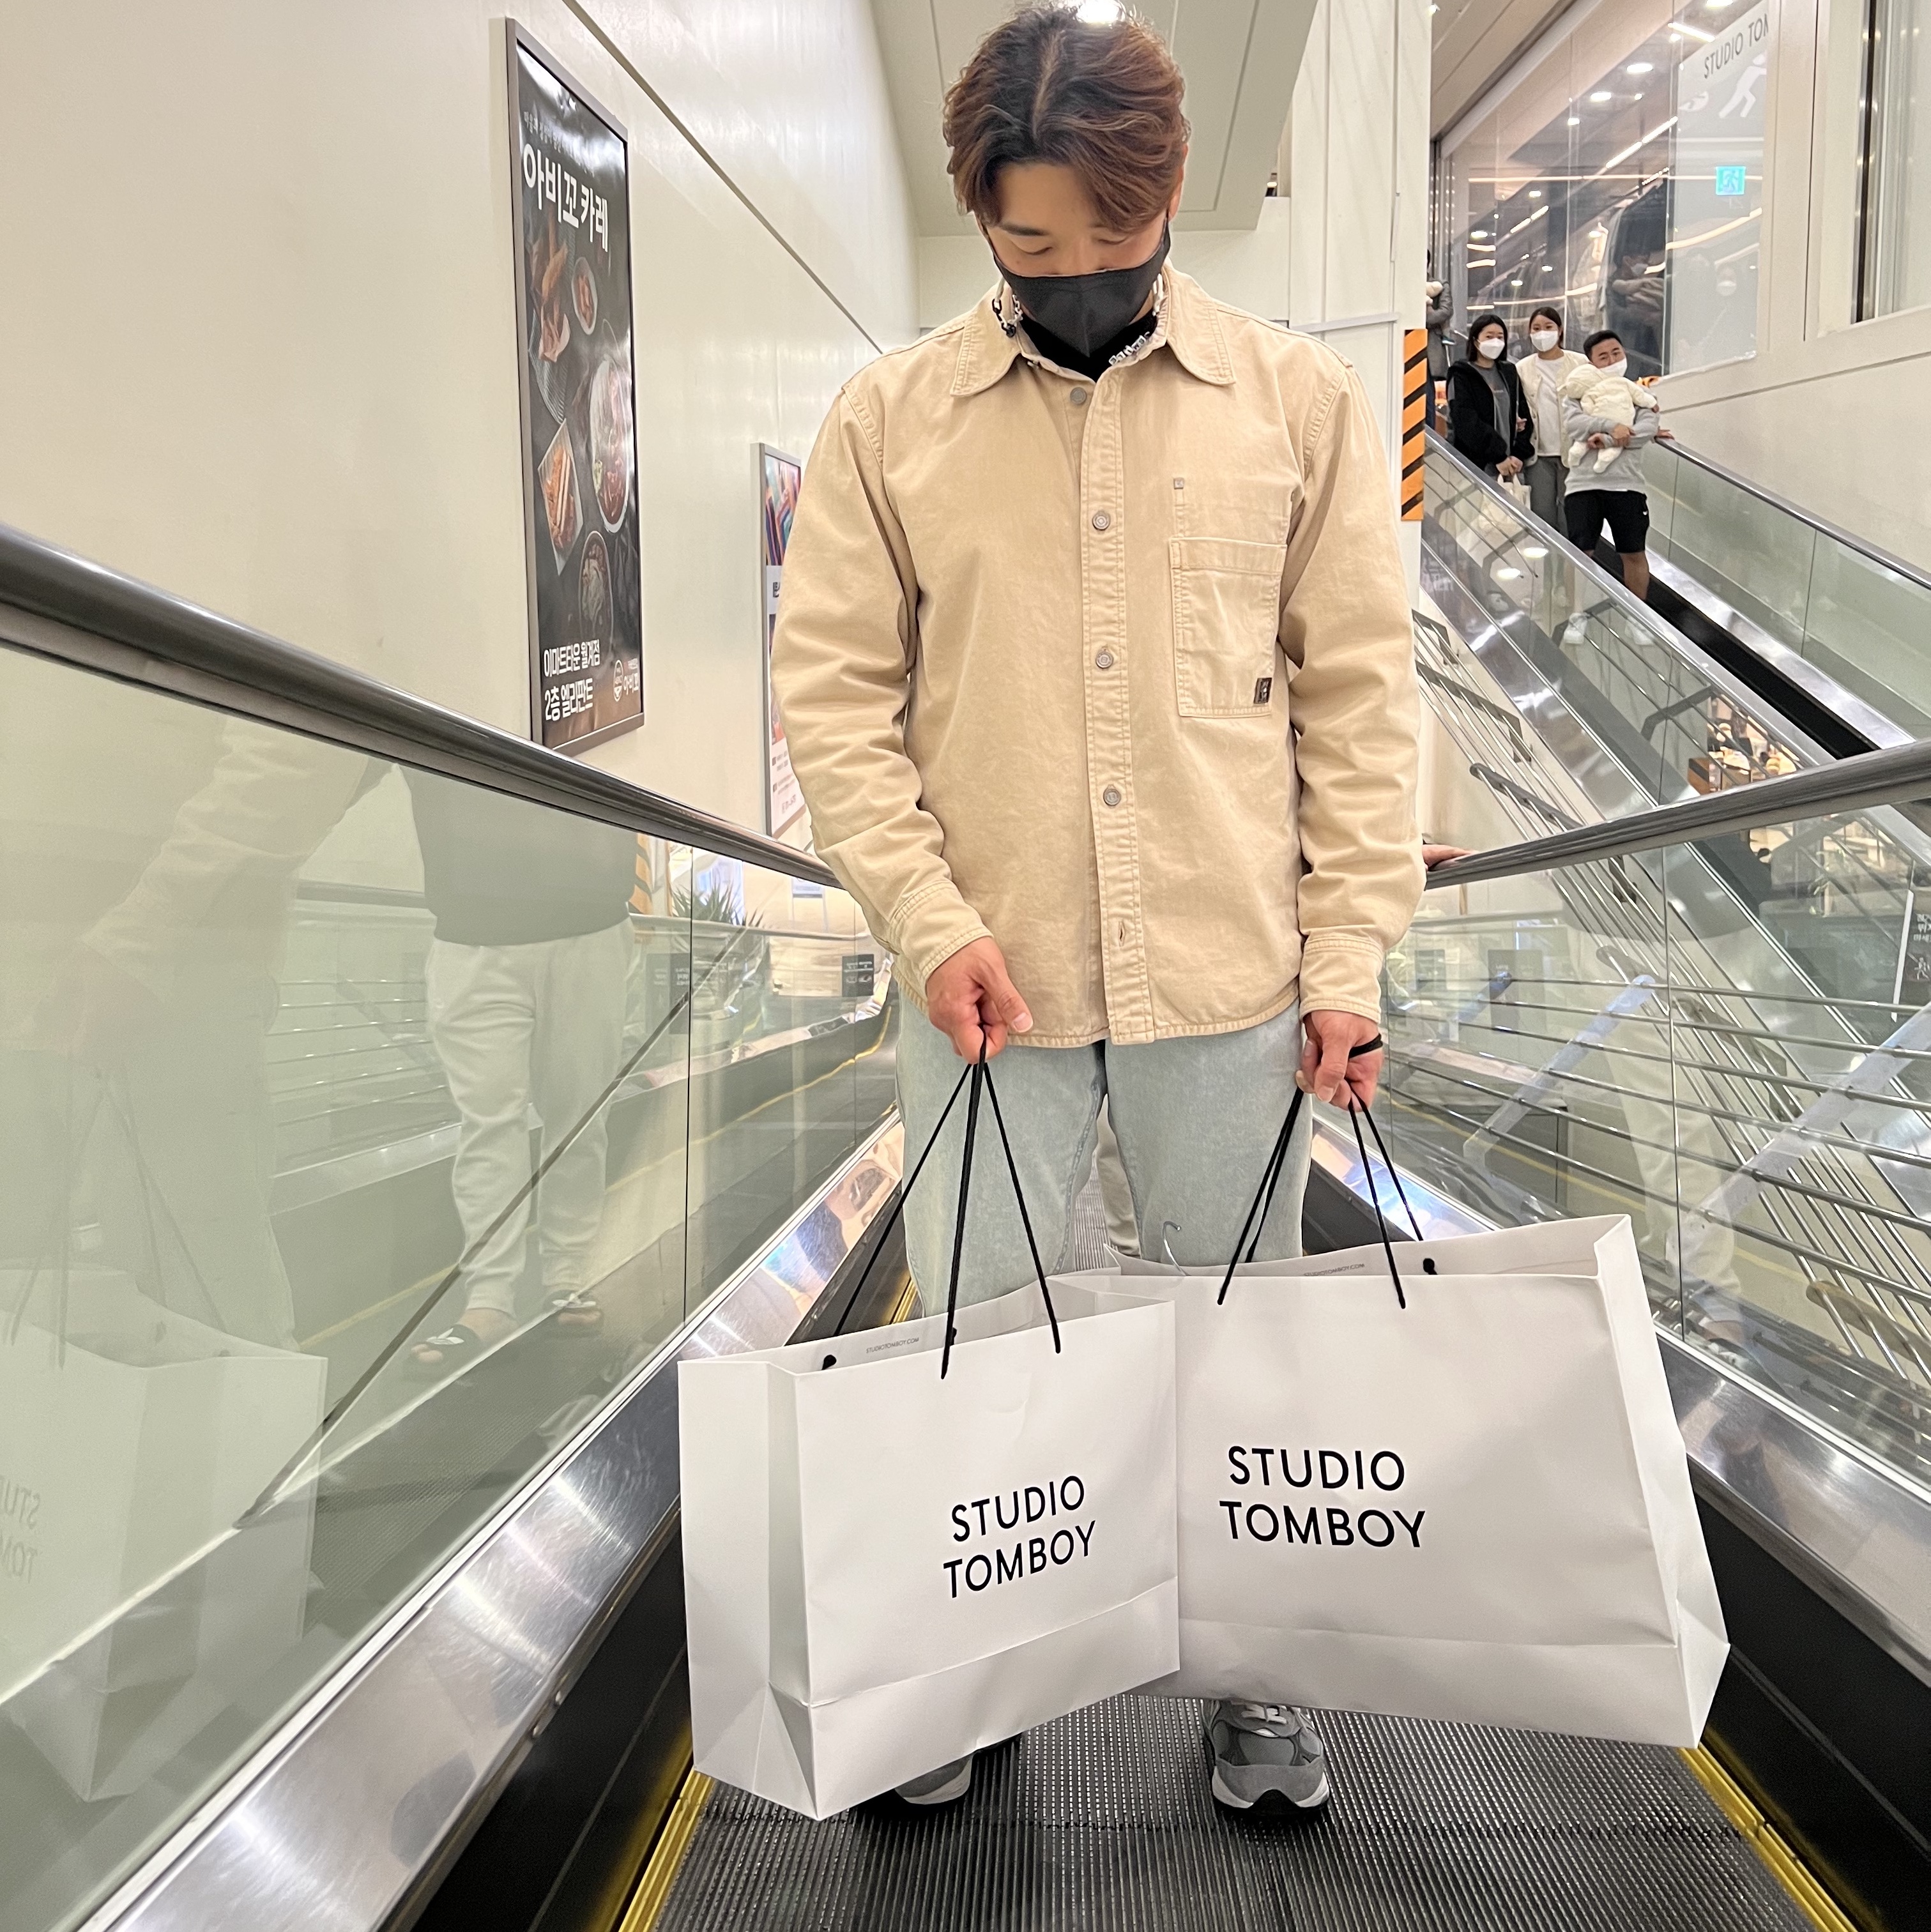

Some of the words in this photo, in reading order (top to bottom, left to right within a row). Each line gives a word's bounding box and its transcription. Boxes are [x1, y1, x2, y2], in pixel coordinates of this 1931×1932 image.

[1704, 33, 1743, 79] STUDIO
[544, 643, 581, 678] 이마트타운
[581, 639, 600, 669] 월계점
[544, 685, 560, 721] 2층
[866, 1337, 920, 1353] STUDIOTOMBOY.COM
[1228, 1446, 1405, 1491] STUDIO
[952, 1475, 1085, 1542] STUDIO
[1219, 1500, 1426, 1548] TOMBOY
[943, 1520, 1096, 1599] TOMBOY
